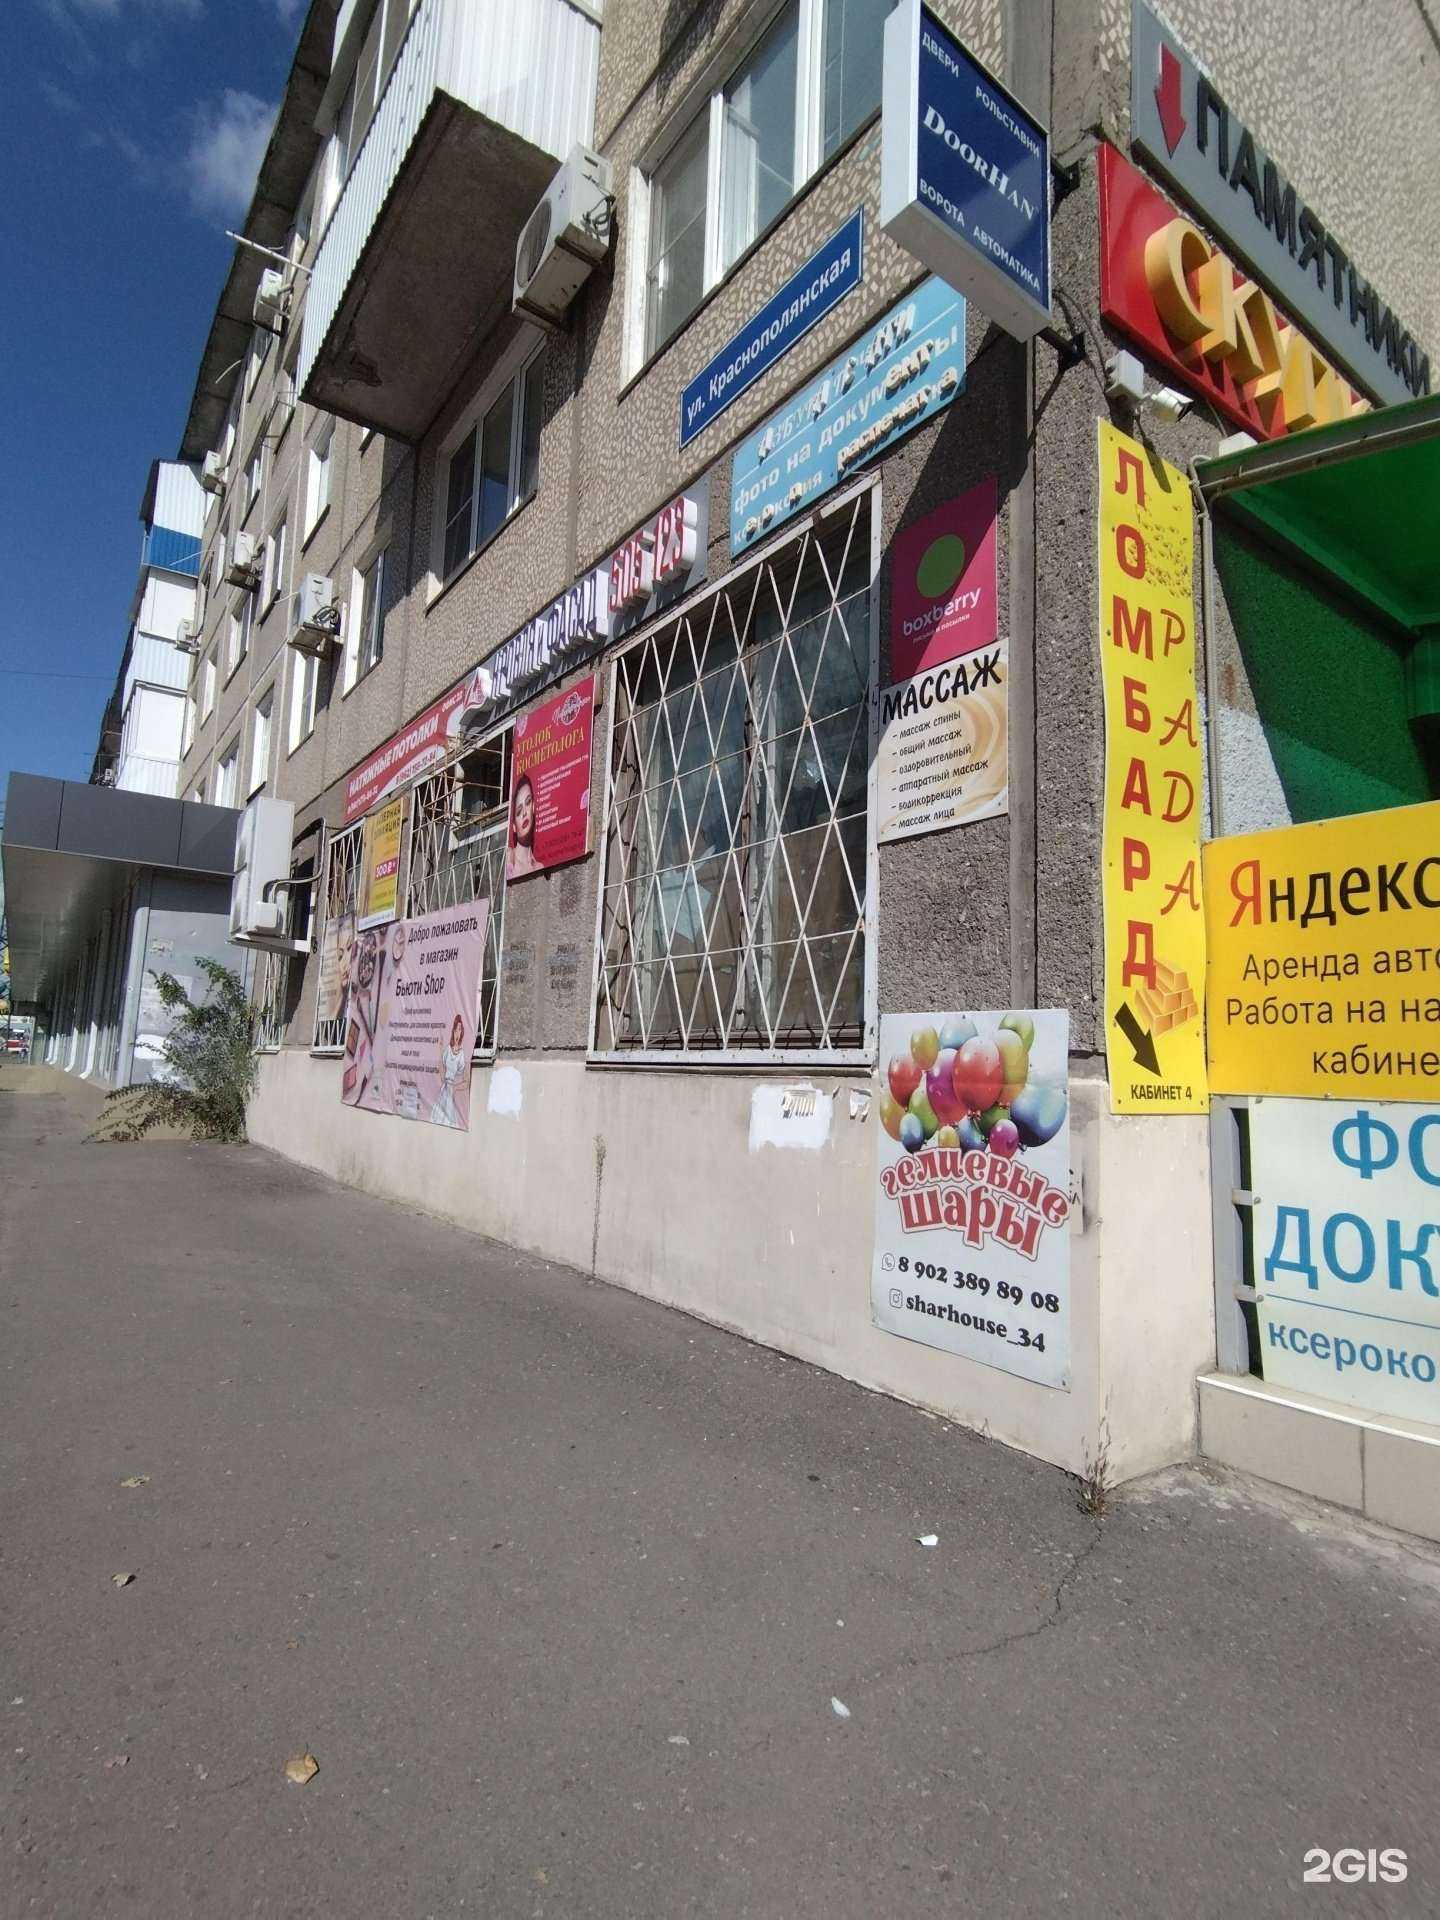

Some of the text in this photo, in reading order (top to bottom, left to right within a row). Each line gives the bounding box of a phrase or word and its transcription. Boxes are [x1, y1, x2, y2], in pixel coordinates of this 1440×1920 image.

[922, 32, 1040, 158] ДВЕРИ РОЛЬСТАВНИ
[920, 178, 1040, 291] ВОРОТА АВТОМАТИКА
[1197, 80, 1430, 397] ПАМЯТНИКИ
[687, 248, 851, 428] ул. Краснополянская
[734, 325, 957, 515] фото на документы
[903, 587, 981, 636] boxberry
[882, 648, 1002, 724] МАССАЖ
[516, 724, 552, 757] УГОЛОК
[899, 710, 961, 739] массаж спины
[899, 728, 962, 757] общий массаж
[1112, 446, 1157, 991] ЛОМБАРД
[515, 727, 584, 776] КОСМЕТОЛОГА
[898, 758, 989, 794] аппаратный массаж
[899, 745, 972, 775] оздоровительный
[899, 807, 955, 829] массаж лица
[1229, 857, 1440, 928] Яндекс
[408, 917, 478, 945] Добро пожаловать
[419, 949, 458, 965] в магазин
[1242, 947, 1440, 986] Аренда авт
[424, 974, 445, 996] Shop
[1227, 996, 1333, 1025] Работа
[1347, 1000, 1386, 1023] на
[1131, 1084, 1193, 1100] КАБИНЕТ 4
[1264, 1205, 1440, 1298] ДОК
[898, 1256, 1059, 1314] 8 902 389 89 08
[906, 1295, 1046, 1353] sharhouse_34
[1268, 1321, 1436, 1383] ксероко
